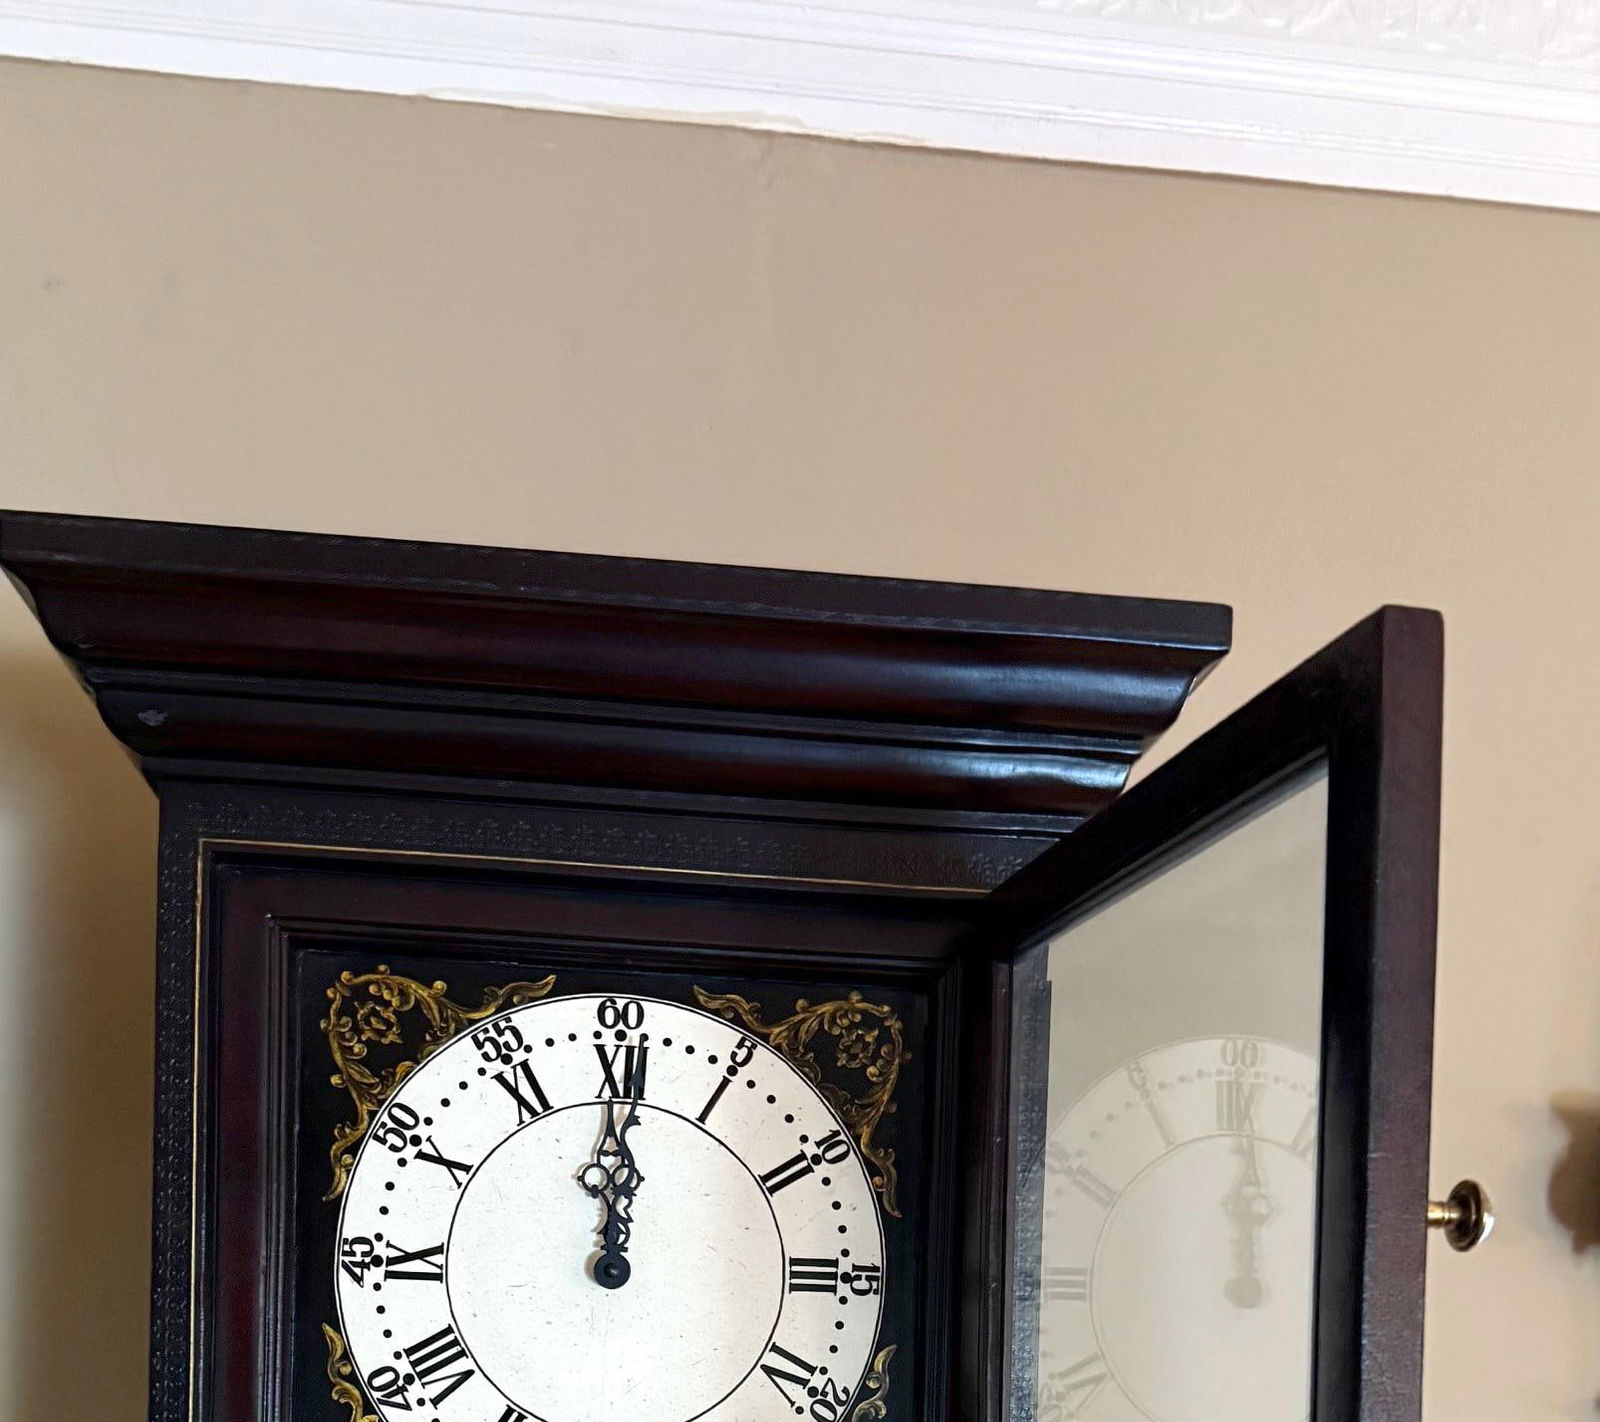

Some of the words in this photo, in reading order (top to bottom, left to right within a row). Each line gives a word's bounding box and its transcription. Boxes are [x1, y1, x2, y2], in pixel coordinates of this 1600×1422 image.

[596, 998, 644, 1030] 60
[471, 1016, 524, 1063] 55
[730, 1035, 758, 1068] 5
[491, 1058, 554, 1126] XI
[593, 1043, 650, 1101] XII
[696, 1075, 734, 1124] I
[373, 1102, 421, 1154] 50
[814, 1128, 851, 1165] 10
[413, 1136, 474, 1189] X
[758, 1149, 815, 1197] II
[341, 1236, 374, 1287] 45
[384, 1241, 445, 1284] IX
[789, 1256, 839, 1294] III
[849, 1263, 880, 1297] 15
[367, 1365, 414, 1412] 40
[403, 1323, 476, 1410] VIII
[760, 1341, 819, 1408] IV
